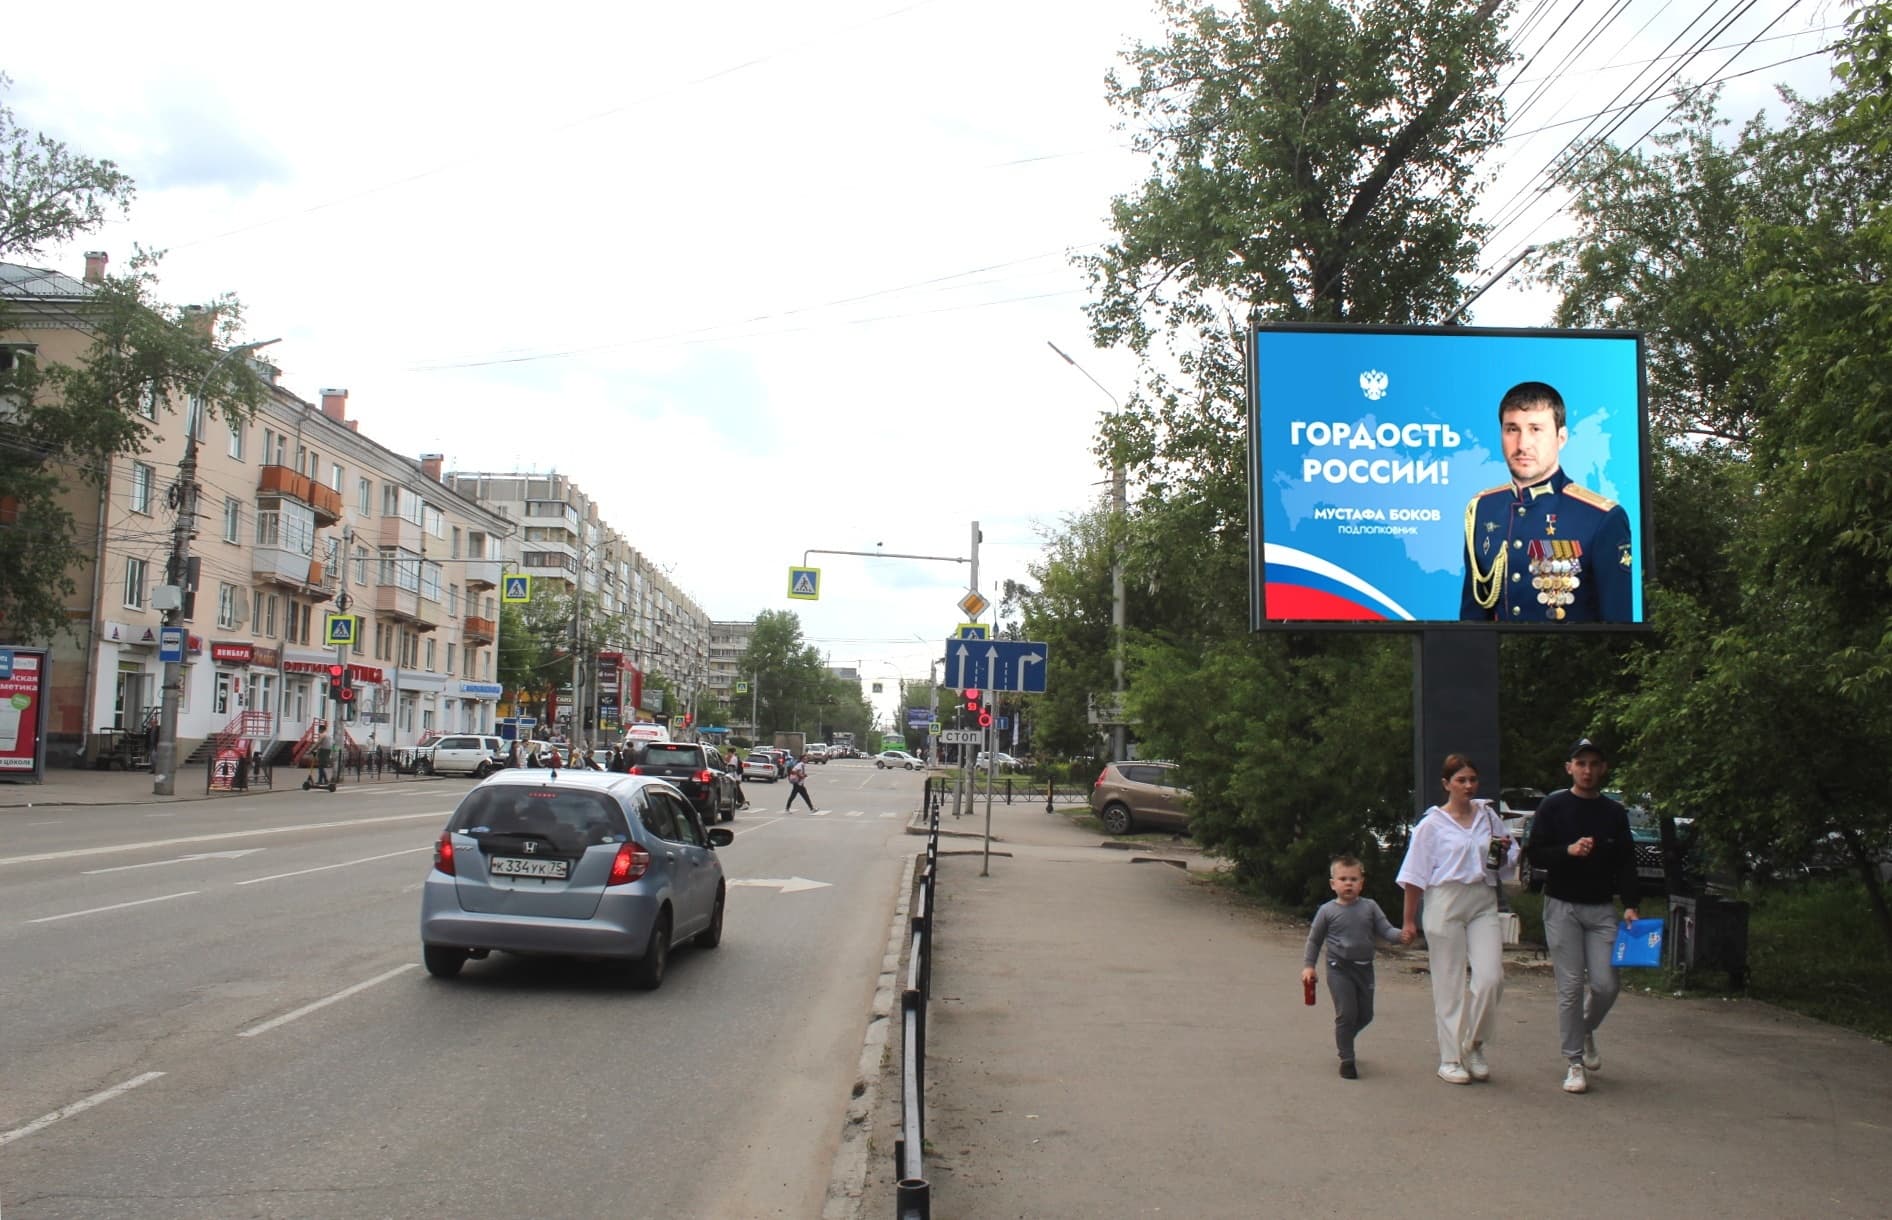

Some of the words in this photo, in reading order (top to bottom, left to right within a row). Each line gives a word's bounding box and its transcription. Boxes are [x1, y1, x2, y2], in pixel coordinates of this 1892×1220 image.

[1291, 421, 1461, 450] ГОРДОСТЬ
[1303, 458, 1449, 486] РОССИИ!
[1314, 508, 1385, 521] МУСТАФА
[1389, 508, 1441, 522] БОКОВ
[946, 732, 977, 742] СТОП
